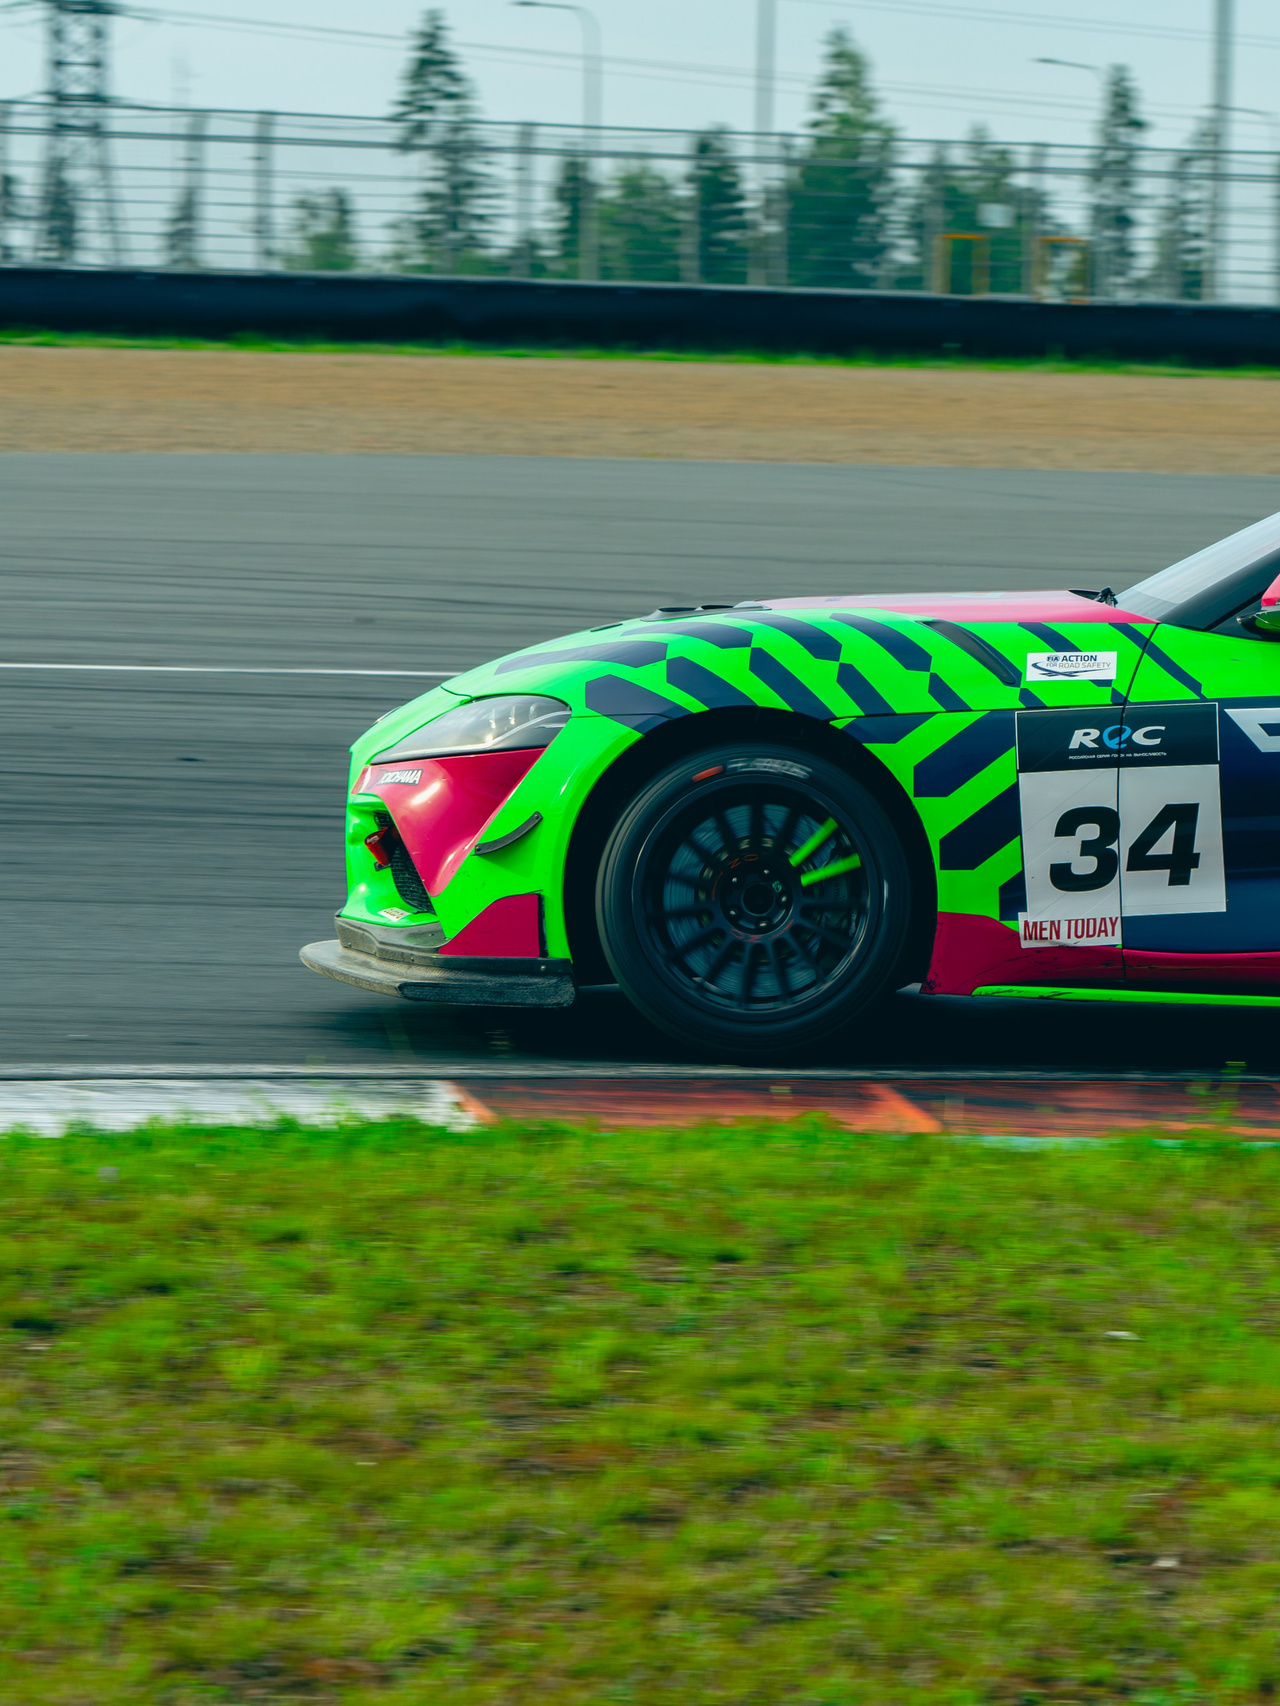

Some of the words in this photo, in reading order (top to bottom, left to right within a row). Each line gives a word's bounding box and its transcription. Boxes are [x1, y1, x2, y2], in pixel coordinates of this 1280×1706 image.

[1061, 654, 1098, 662] ACTION
[1081, 661, 1112, 669] SAFETY
[1049, 803, 1201, 893] 34
[1023, 919, 1061, 942] MEN
[1064, 916, 1119, 940] TODAY
